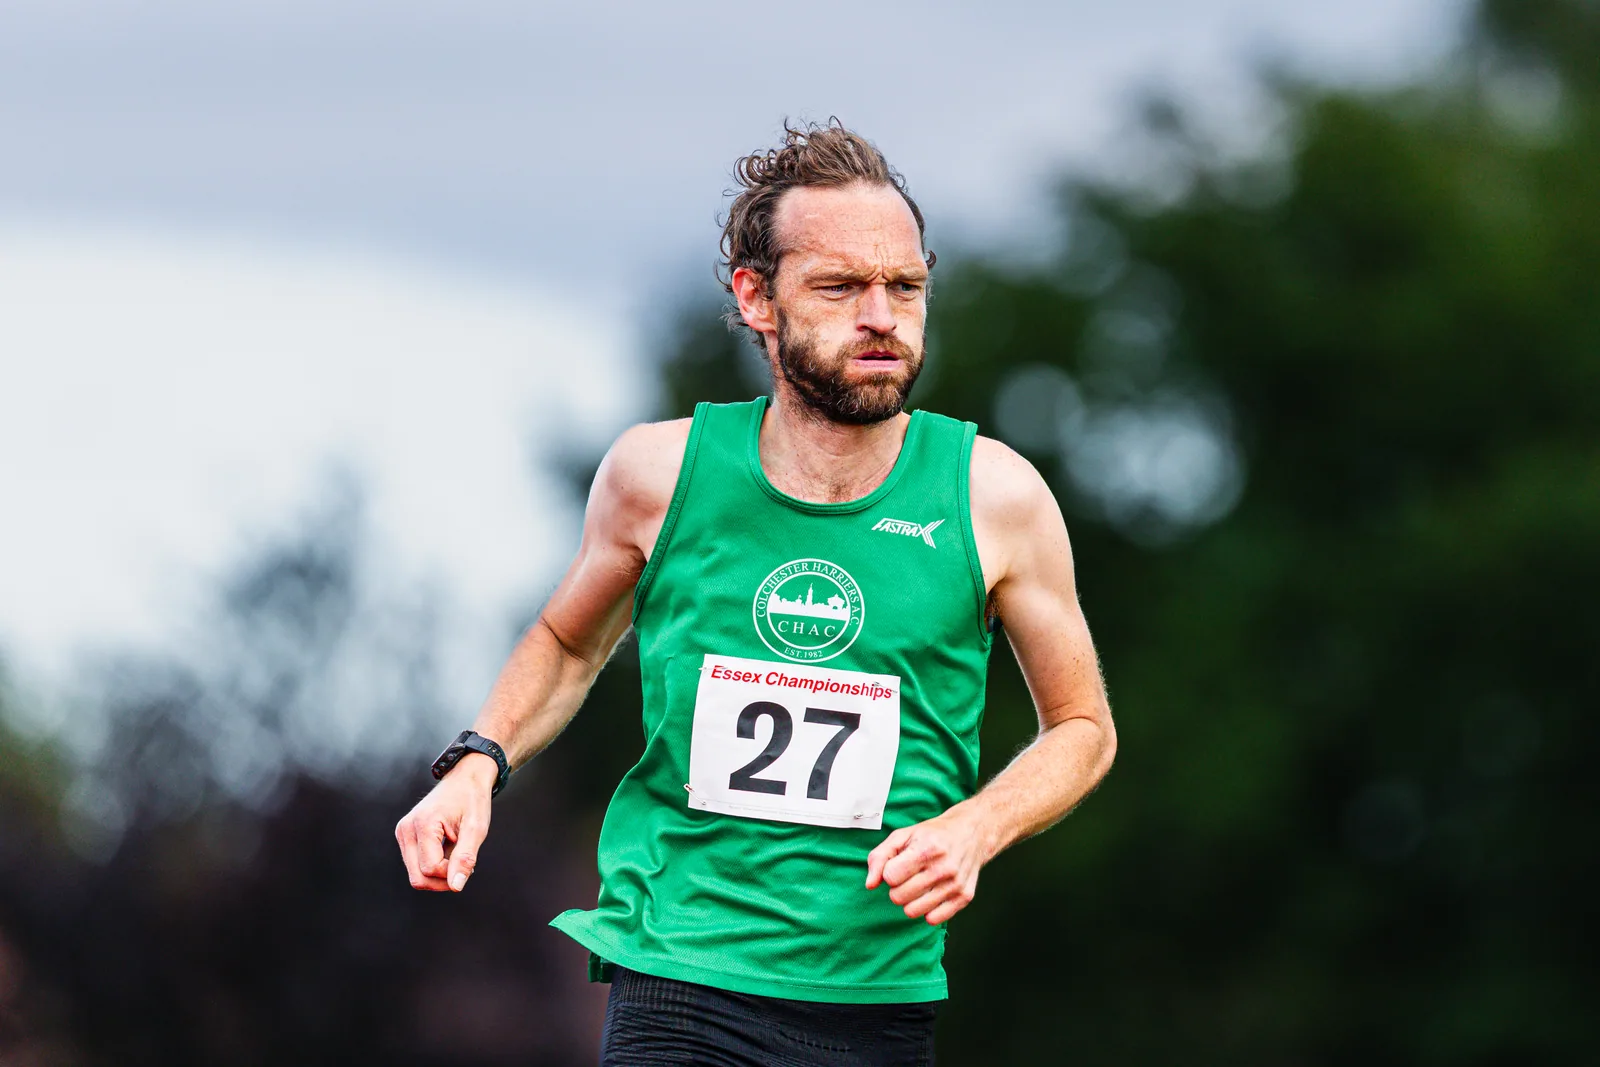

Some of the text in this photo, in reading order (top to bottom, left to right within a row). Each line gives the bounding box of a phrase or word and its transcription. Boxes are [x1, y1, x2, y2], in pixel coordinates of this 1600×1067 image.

[871, 517, 945, 549] FASTRAX
[757, 562, 809, 617] COLCHESTER
[813, 562, 860, 603] HARRIERS
[778, 620, 835, 637] CHAC
[711, 665, 892, 700] Essex Championships
[728, 701, 861, 800] 27
